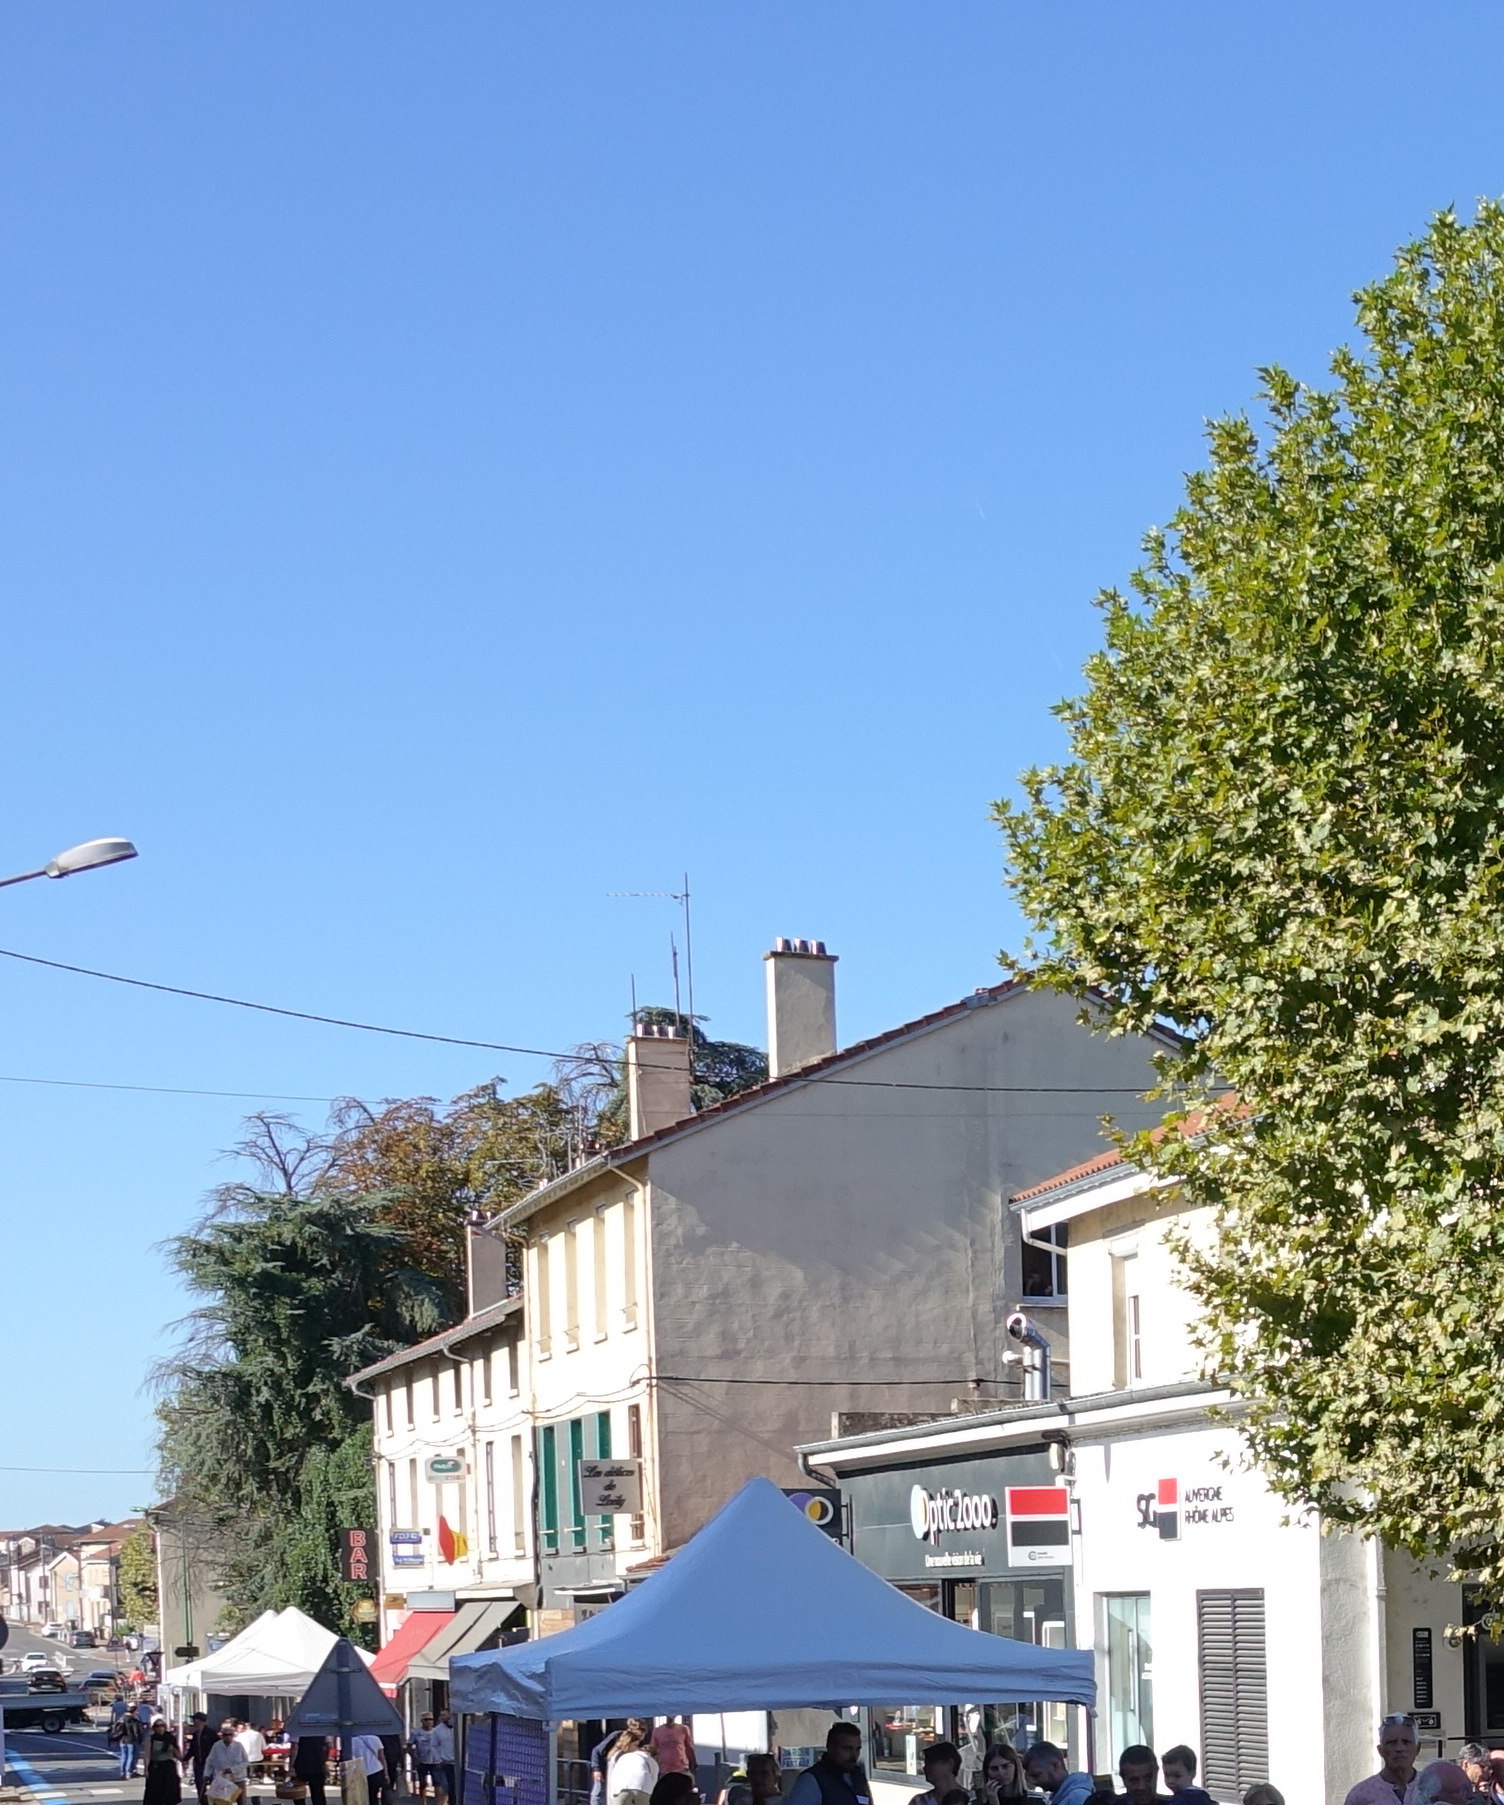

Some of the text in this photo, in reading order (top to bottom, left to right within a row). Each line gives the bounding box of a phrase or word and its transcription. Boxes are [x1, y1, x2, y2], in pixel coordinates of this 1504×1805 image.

[1185, 1486, 1223, 1503] AUVERGNE
[1136, 1492, 1160, 1529] SG
[1185, 1505, 1235, 1524] RHÔNE ALPES
[349, 1530, 369, 1580] BAR
